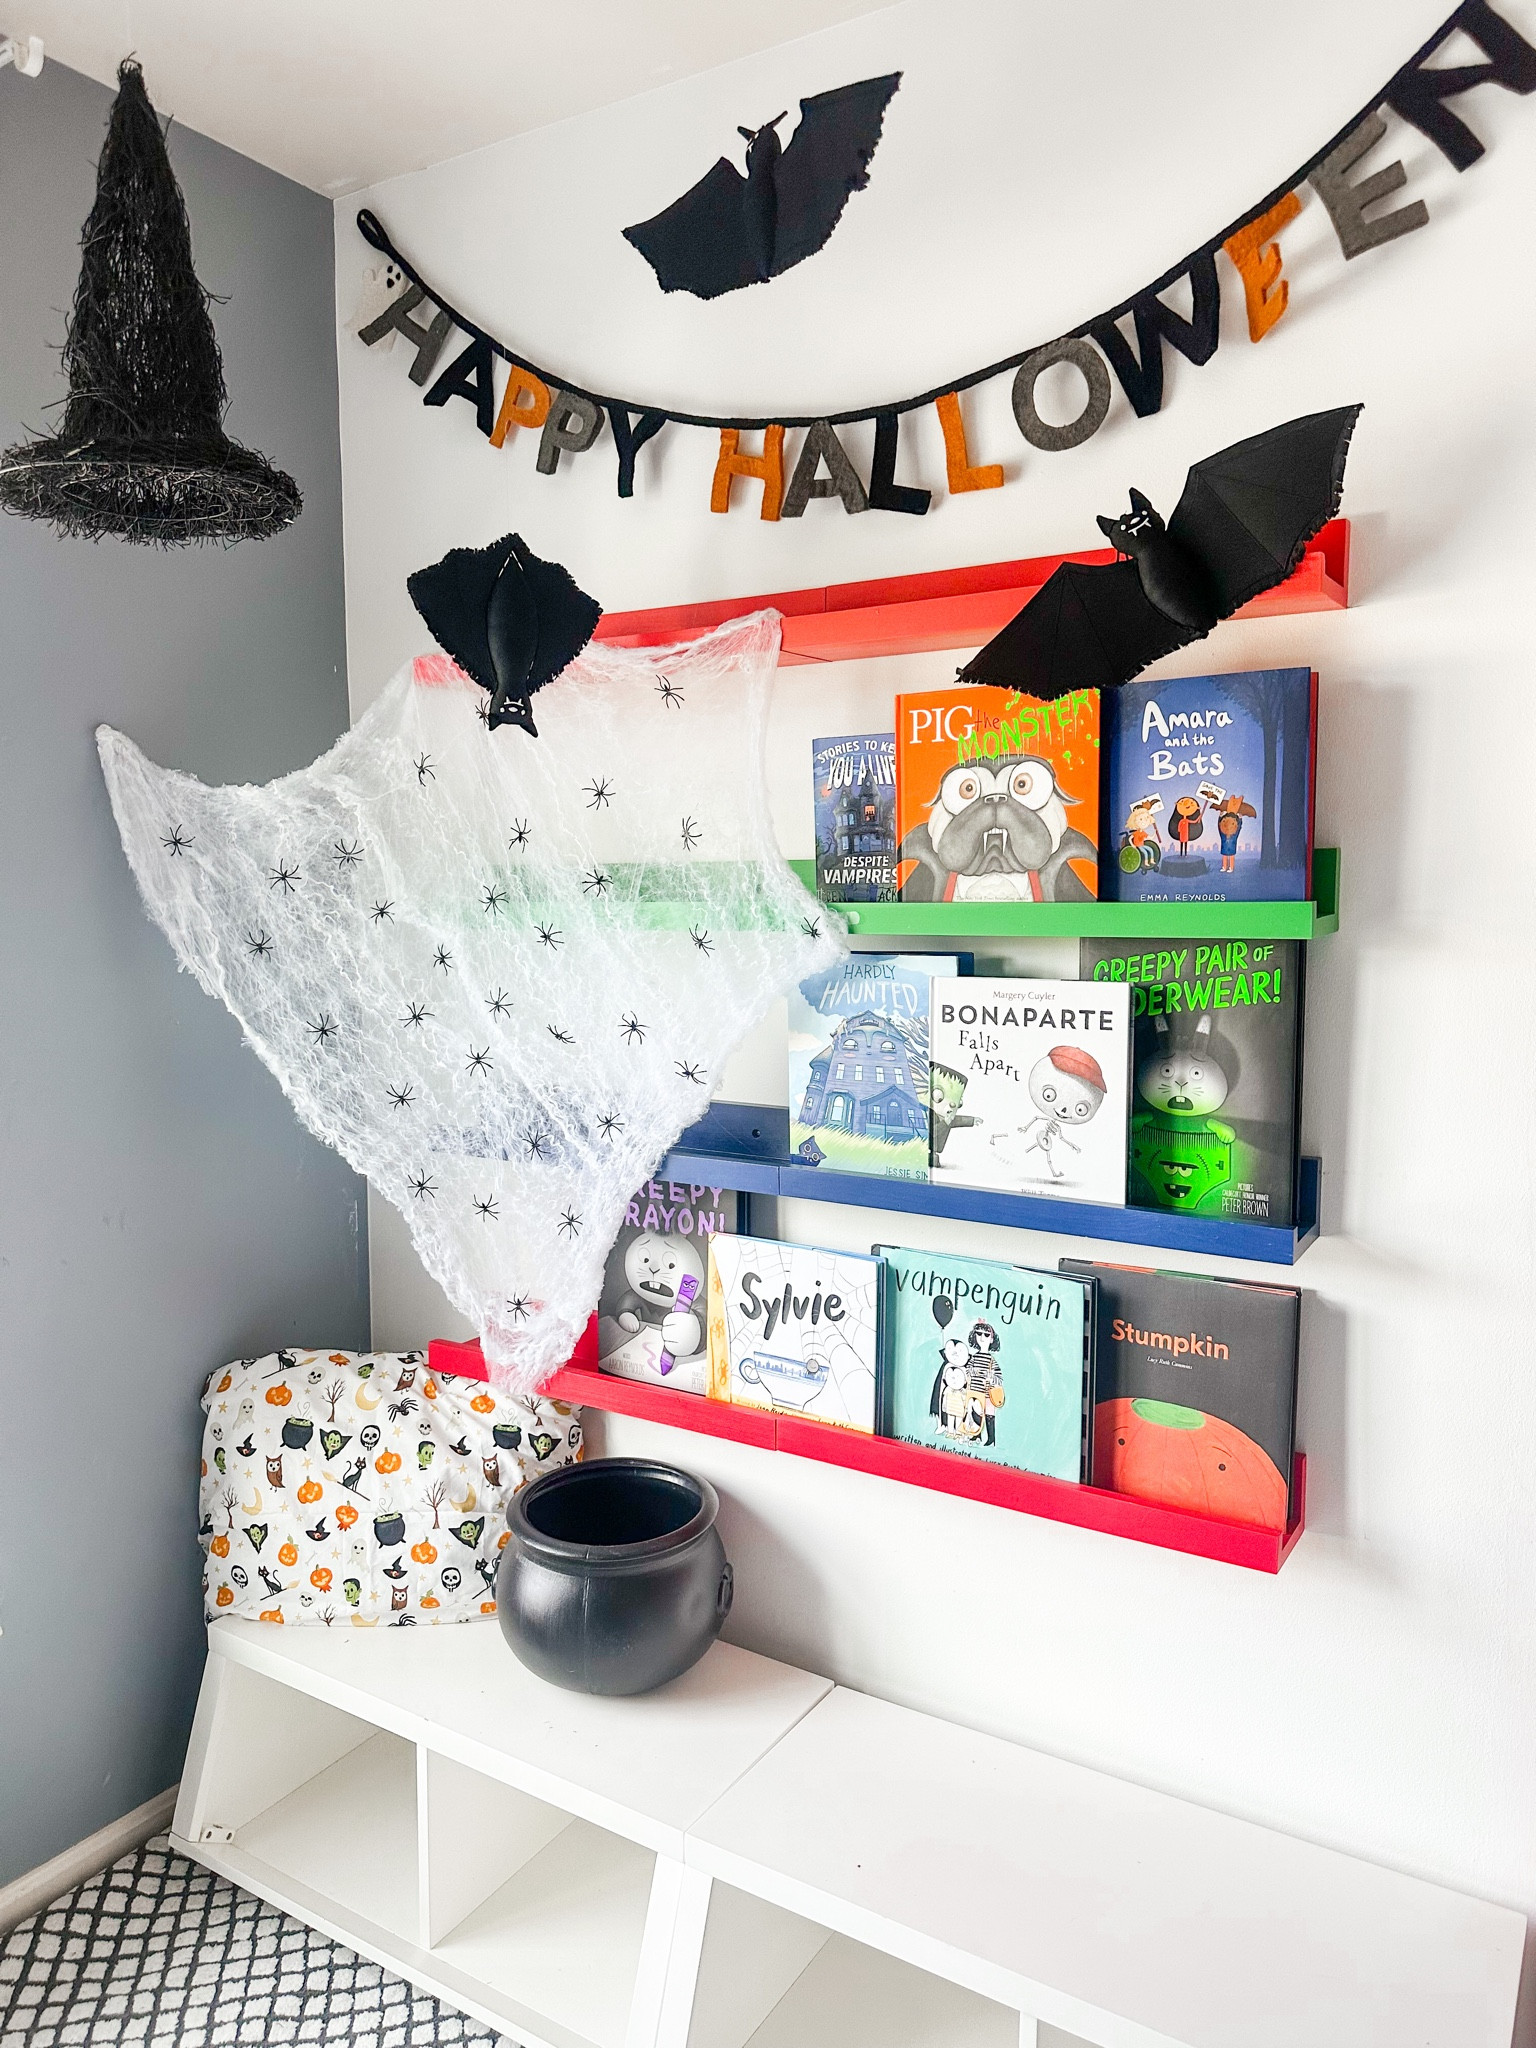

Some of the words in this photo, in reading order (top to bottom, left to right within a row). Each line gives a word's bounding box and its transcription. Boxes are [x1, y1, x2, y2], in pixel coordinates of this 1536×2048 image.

[357, 284, 668, 499] HAPPY
[711, 0, 1536, 522] HALLOWEEN
[909, 705, 976, 744] PIG
[974, 709, 1000, 732] the
[957, 689, 1093, 766] MONSTER
[1142, 700, 1234, 743] Amara
[817, 740, 860, 764] STORIES
[864, 740, 878, 751] TO
[880, 741, 896, 754] KE
[1164, 732, 1190, 747] and
[1192, 732, 1215, 746] the
[826, 756, 854, 790] YOU
[1147, 750, 1225, 781] Bats
[823, 867, 898, 884] VAMPIRES
[843, 855, 890, 868] DESPITE
[1140, 893, 1168, 902] EMMA
[1175, 893, 1226, 902] REYNOLDS
[843, 964, 896, 980] HARDLY
[1093, 948, 1188, 983] CREEPY
[1195, 941, 1248, 976] PAIR
[1253, 945, 1274, 962] OF
[819, 980, 918, 1017] HAUNTED
[992, 990, 1026, 1002] Margery
[1027, 991, 1056, 1002] Cuyler
[1134, 969, 1281, 1017] DERWEAR!
[941, 1004, 1114, 1031] BONAPARTE
[958, 1030, 1000, 1052] Falls
[970, 1053, 1021, 1082] Apart
[884, 1165, 911, 1178] JESSIE
[625, 1201, 725, 1237] RAYON!
[1221, 1196, 1241, 1214] PETER
[1242, 1199, 1269, 1217] BROWN
[739, 1271, 846, 1341] Sylvie
[895, 1268, 1061, 1325] vampenguin
[1111, 1318, 1230, 1360] Stumpkin
[893, 1434, 922, 1446] written
